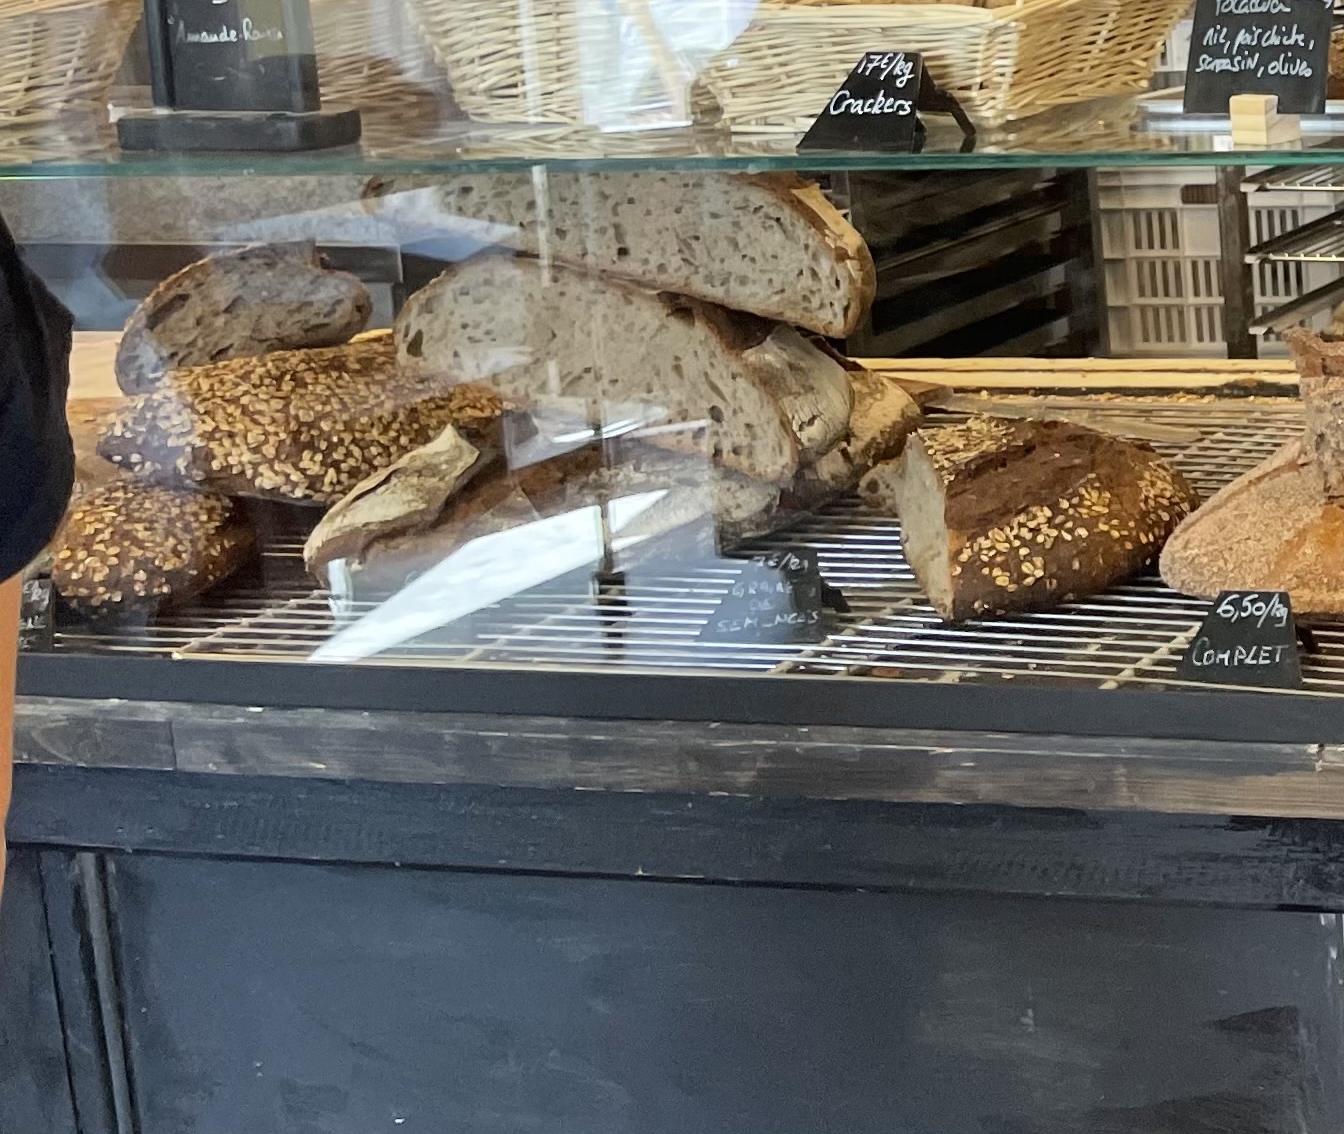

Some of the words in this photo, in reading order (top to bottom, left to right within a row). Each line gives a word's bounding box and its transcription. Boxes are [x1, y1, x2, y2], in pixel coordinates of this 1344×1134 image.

[857, 52, 915, 88] 17€/kg
[1268, 51, 1314, 78] olives
[829, 89, 913, 115] Crackers
[1216, 593, 1289, 628] 6,50/kg
[1192, 636, 1291, 667] COMPLET
